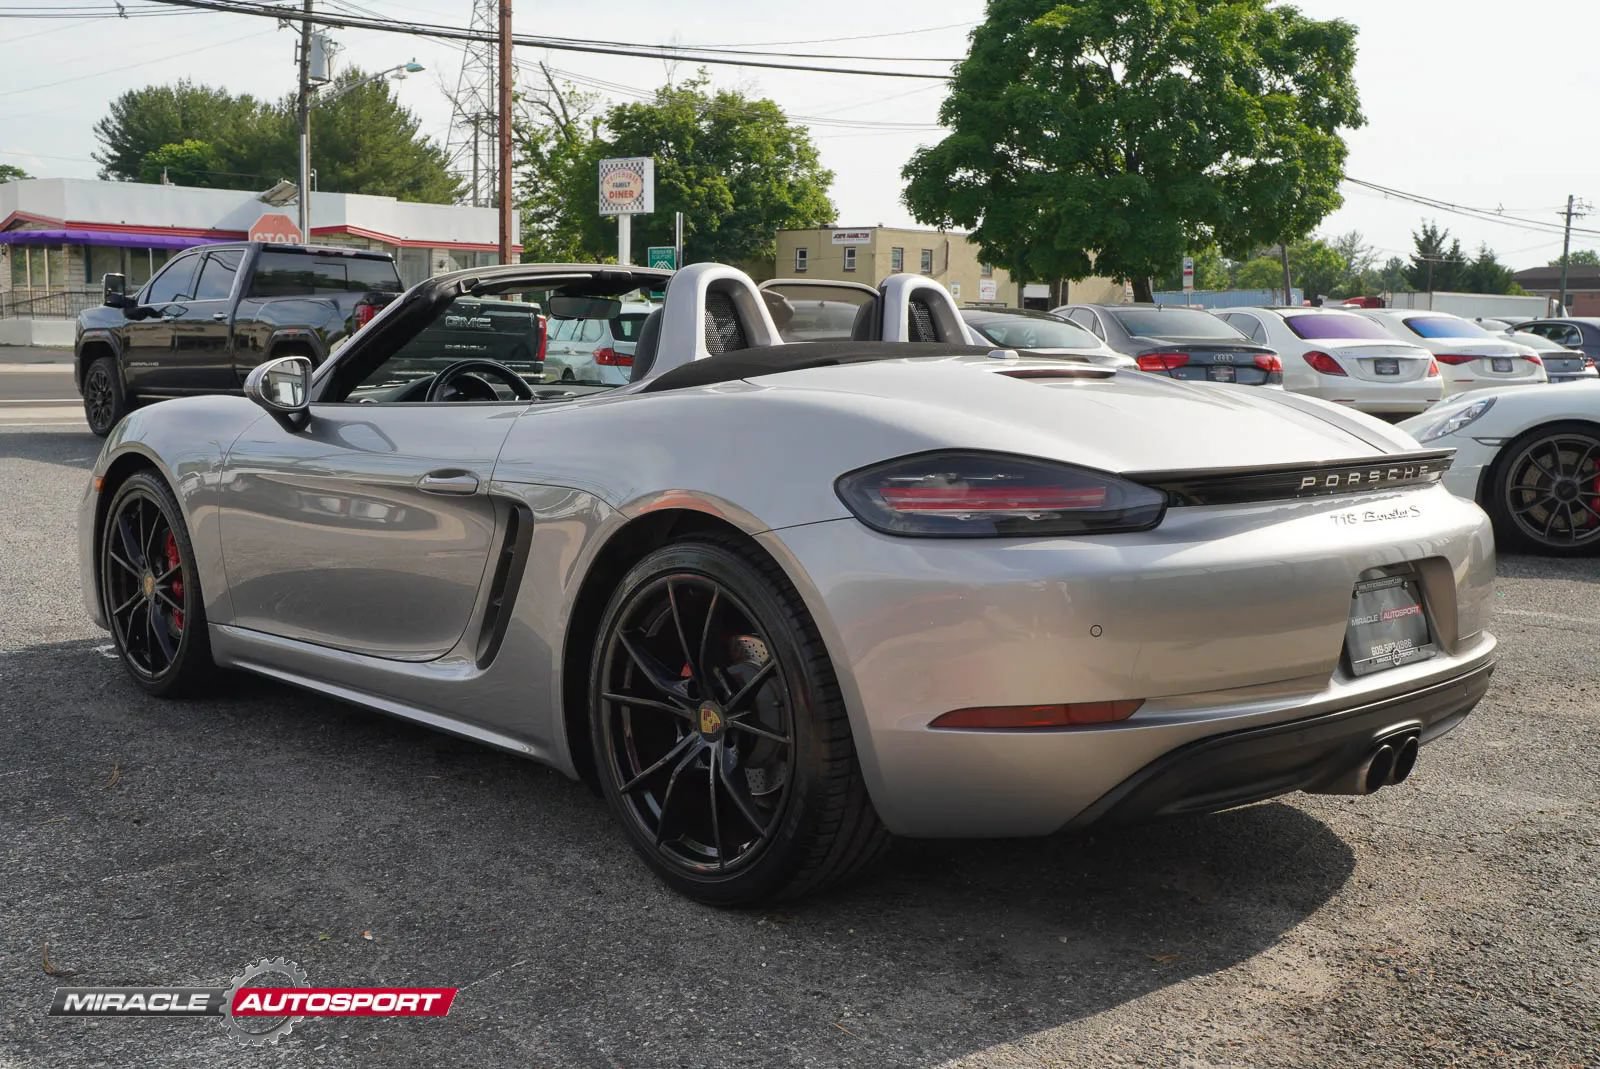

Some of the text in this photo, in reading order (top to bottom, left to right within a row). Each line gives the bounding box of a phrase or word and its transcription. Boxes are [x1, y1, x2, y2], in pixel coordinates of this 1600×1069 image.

[609, 190, 634, 198] DINER
[446, 316, 491, 328] GMC
[1300, 465, 1429, 489] PORSCHE
[1351, 605, 1420, 626] MIRACLE AUTOSPORT
